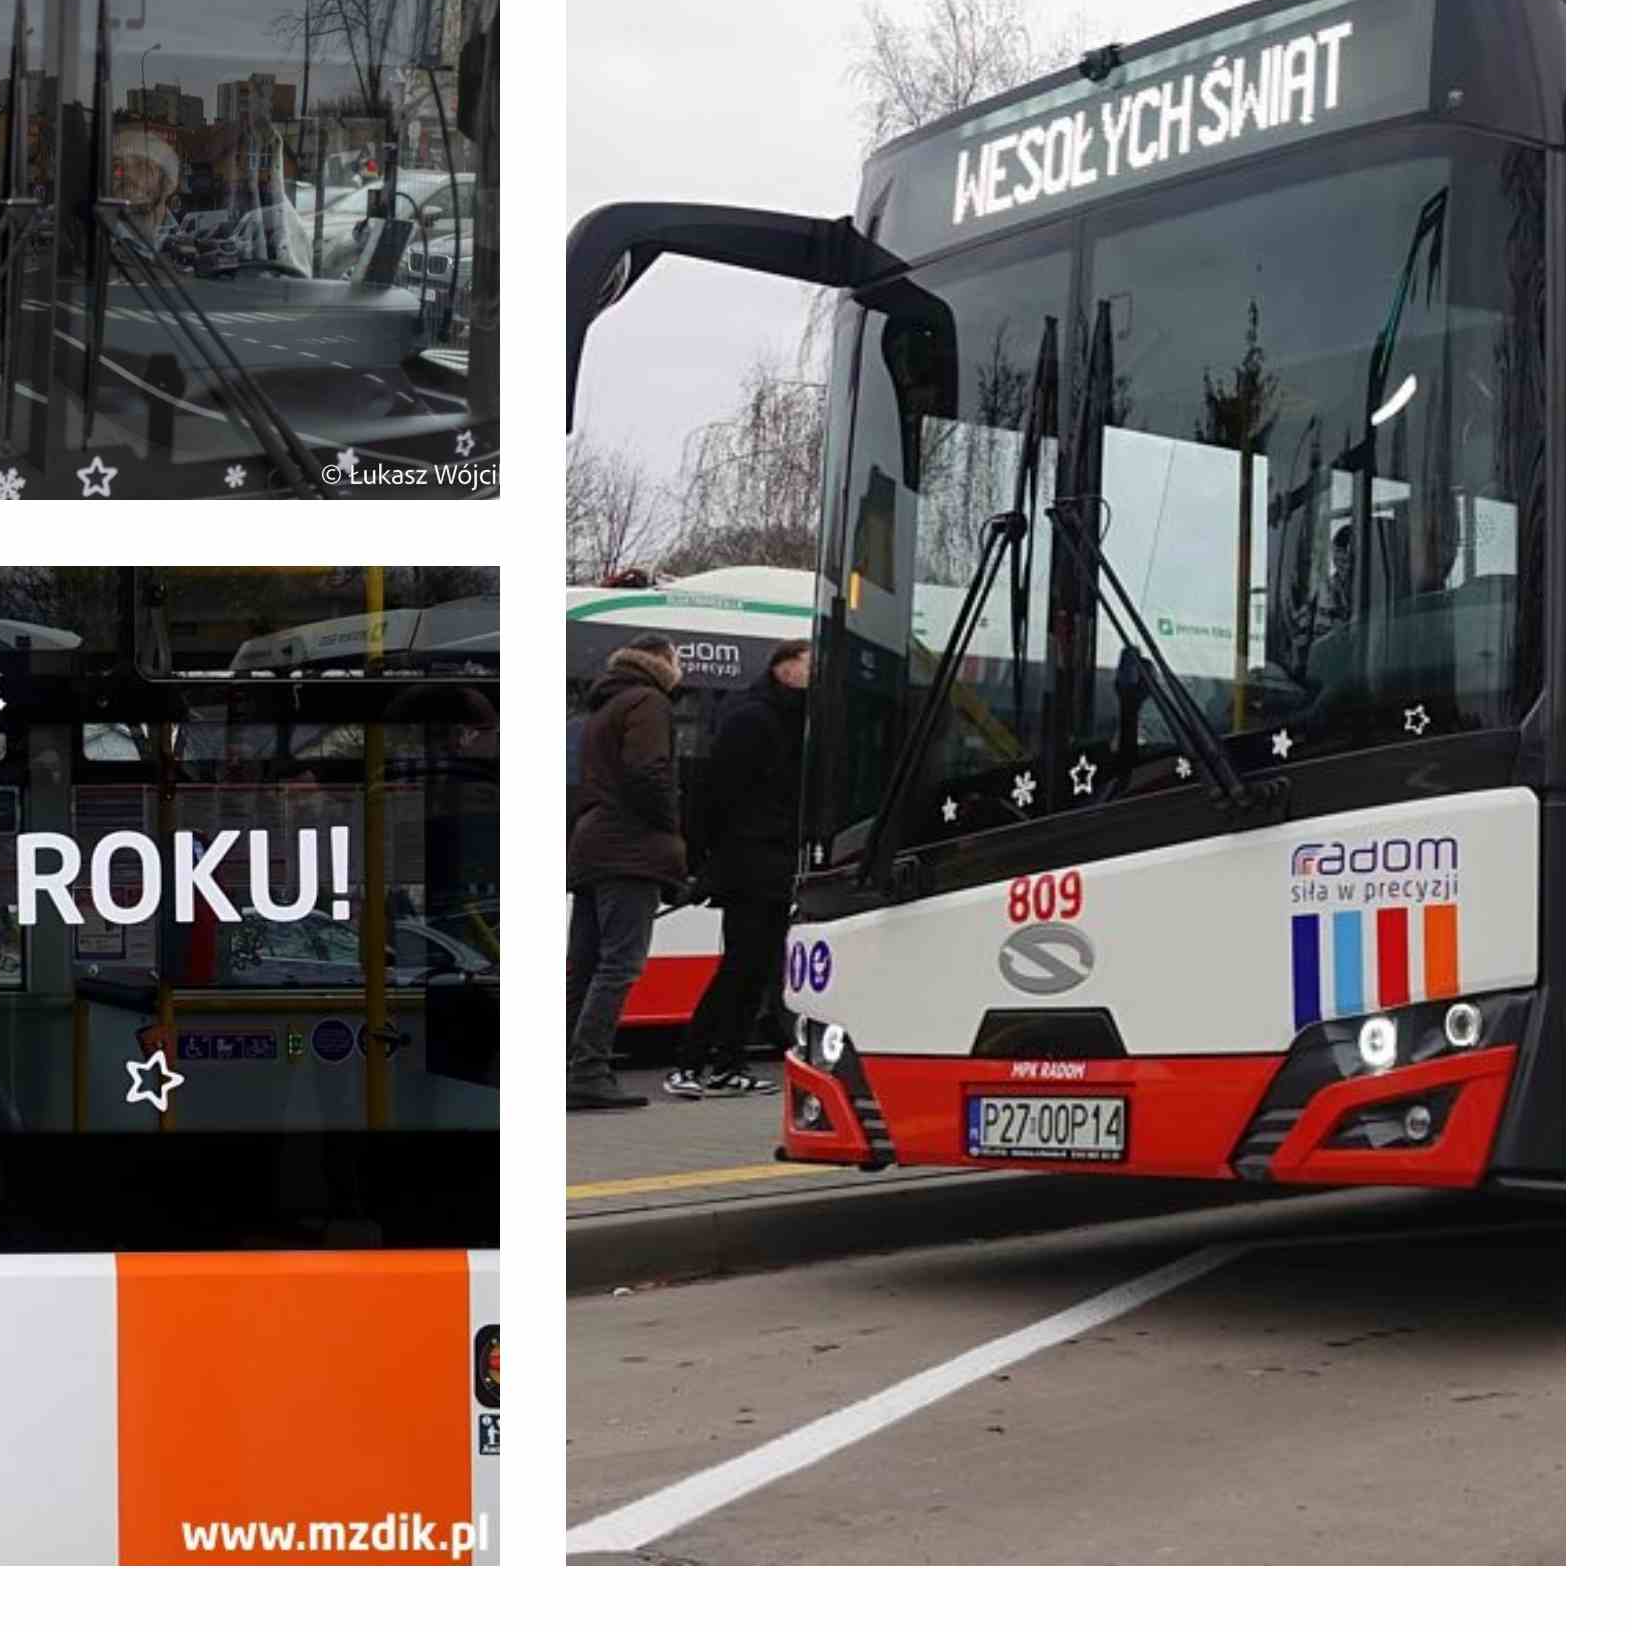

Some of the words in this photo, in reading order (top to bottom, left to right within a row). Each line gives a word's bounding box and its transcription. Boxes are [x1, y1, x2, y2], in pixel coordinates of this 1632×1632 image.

[951, 74, 1194, 226] WESOŁYCH
[1196, 20, 1354, 148] ŚWIĄT
[17, 825, 351, 927] ROKU!
[1291, 836, 1459, 877] radom
[1007, 868, 1084, 924] 809
[1291, 878, 1329, 903] siła
[1337, 884, 1356, 900] w
[1365, 873, 1459, 903] precyzji
[1010, 1061, 1040, 1079] MPK
[1040, 1061, 1087, 1079] RADOM
[982, 1102, 1032, 1144] P27
[181, 1512, 490, 1561] www.mzdik.pl
